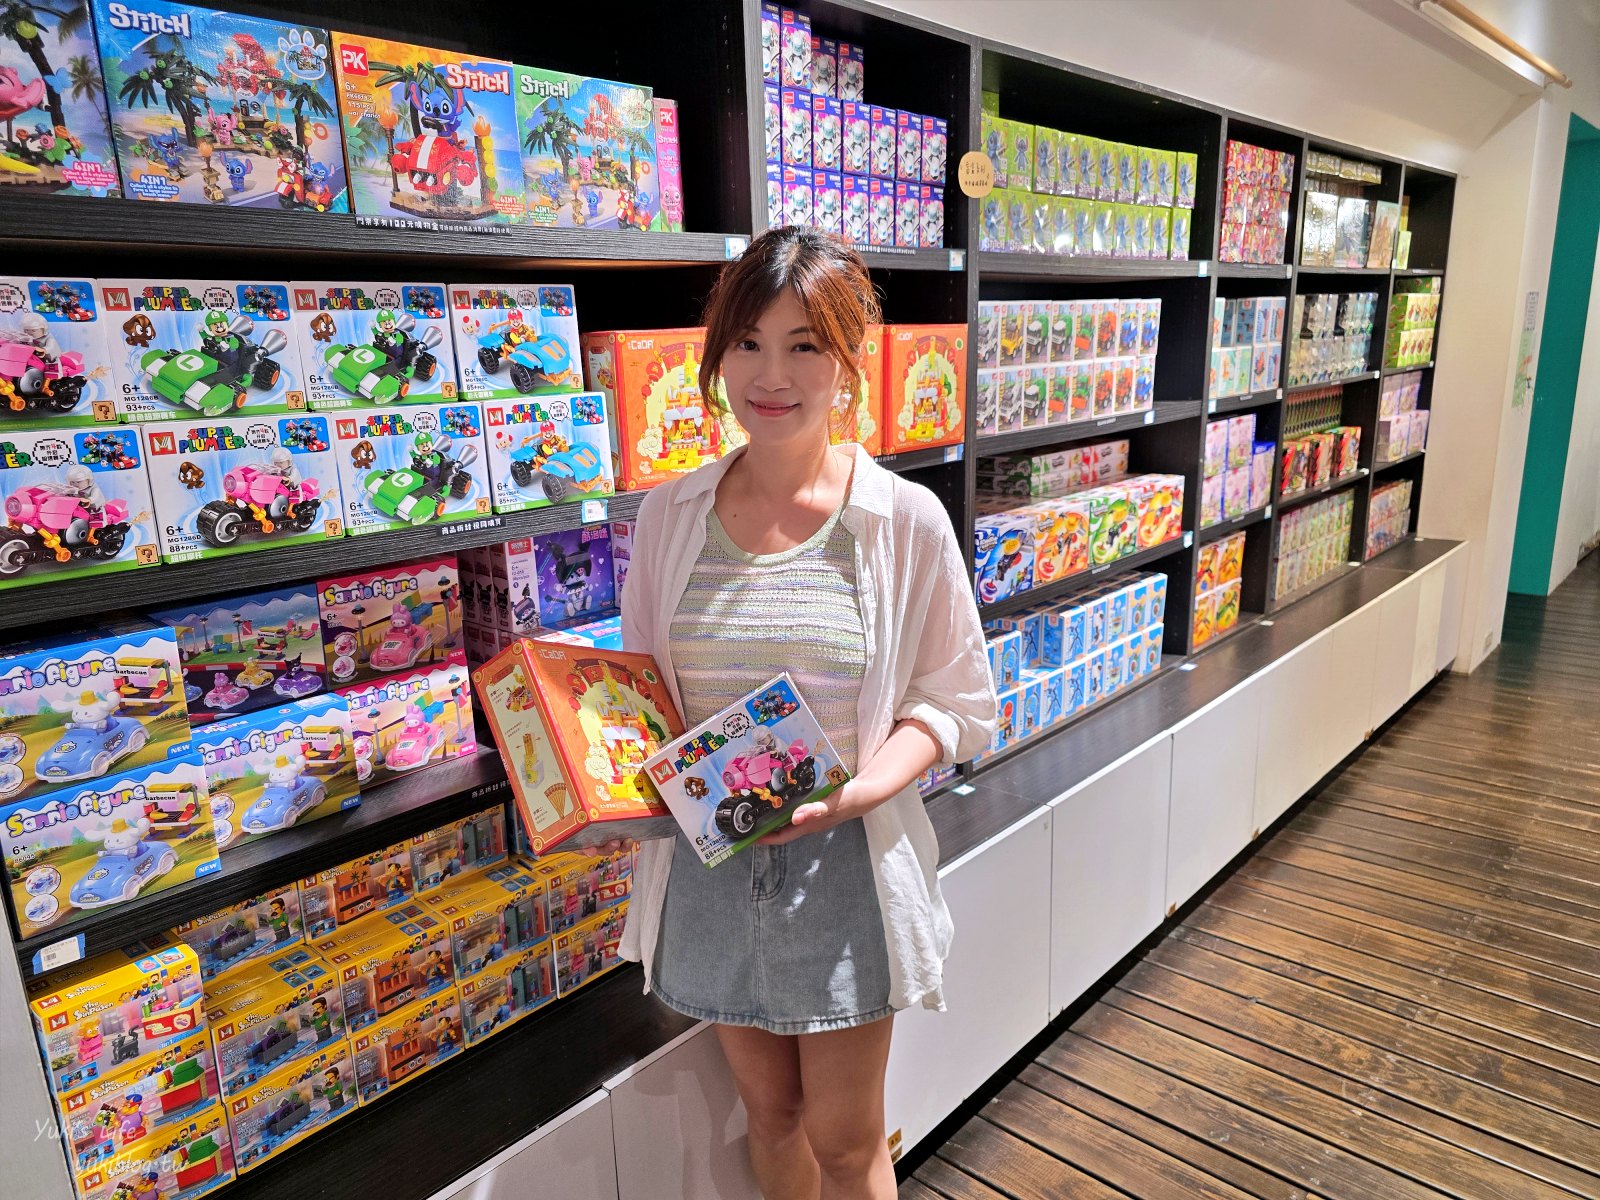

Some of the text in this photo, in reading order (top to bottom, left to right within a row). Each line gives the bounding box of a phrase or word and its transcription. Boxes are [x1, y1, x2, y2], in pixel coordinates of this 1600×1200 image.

[341, 50, 367, 71] PK
[345, 82, 356, 91] 6+
[660, 111, 673, 123] PK
[73, 161, 101, 172] 4IN1
[141, 175, 166, 186] 4IN1
[142, 287, 191, 298] SUPER
[326, 288, 365, 298] SUPER
[134, 297, 204, 311] PLUMBER
[319, 297, 376, 310] PLUMBER
[464, 368, 476, 376] 6+
[310, 374, 324, 384] 6+
[122, 384, 140, 394] 6+
[512, 403, 542, 414] SUPER
[366, 414, 404, 426] SUPER
[506, 411, 550, 425] PLUMBER
[187, 426, 234, 440] SUPER
[360, 422, 414, 438] PLUMBER
[179, 436, 246, 454] PLUMBER
[497, 482, 508, 490] 6+
[350, 502, 364, 510] 6+
[166, 526, 184, 535] 6+
[450, 650, 464, 658] NEW
[172, 744, 190, 754] NEW
[462, 744, 474, 753] NEW
[678, 731, 714, 757] SUPER
[674, 734, 728, 774] PLUMBER
[344, 797, 359, 806] NEW
[6, 801, 80, 838] Sanrio
[696, 834, 709, 846] 6+
[12, 844, 28, 856] 6+
[198, 863, 217, 873] NEW
[83, 1002, 100, 1011] The
[245, 1014, 258, 1022] The
[100, 1080, 115, 1090] The
[260, 1086, 272, 1094] The
